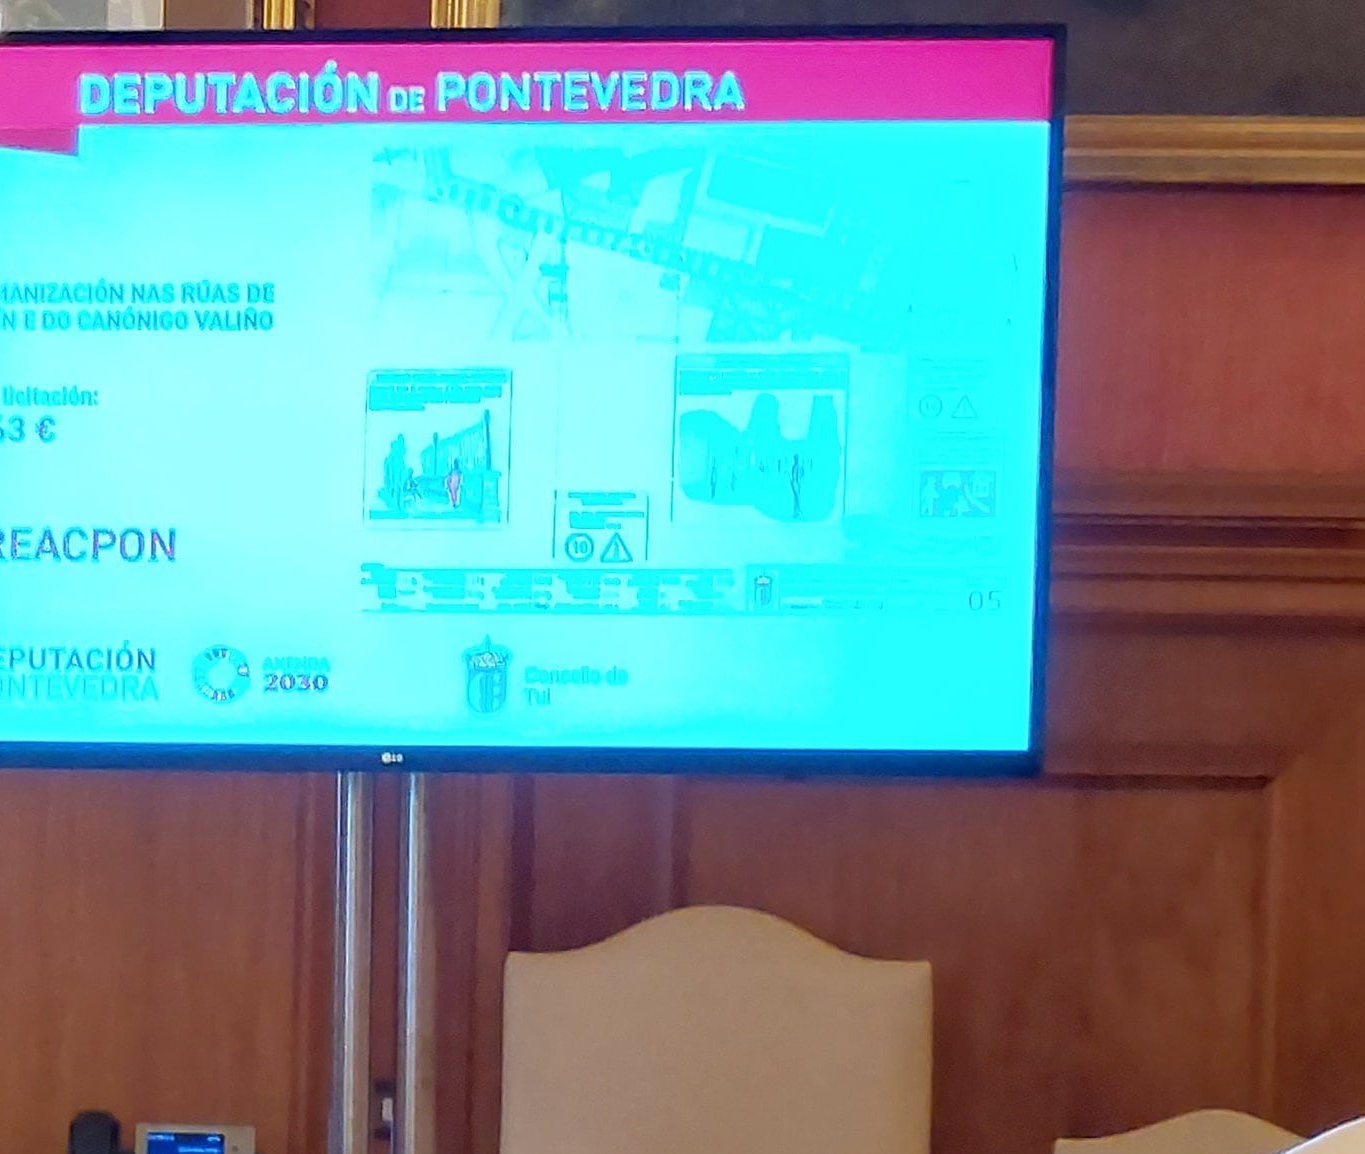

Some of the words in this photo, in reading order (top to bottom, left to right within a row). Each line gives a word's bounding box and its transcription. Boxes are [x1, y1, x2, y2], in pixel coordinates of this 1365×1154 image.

[79, 60, 380, 115] DEPUTACIÓN
[389, 87, 425, 113] DE
[437, 71, 744, 113] PONTEVEDRA
[131, 283, 175, 303] NAS
[181, 280, 240, 303] RÚAS
[247, 283, 275, 303] DE
[42, 312, 70, 330] DO
[194, 307, 274, 331] VALIÑO
[2, 386, 99, 406] licitación:
[35, 417, 56, 442] €
[968, 590, 1002, 612] 05
[263, 674, 330, 693] 2030
